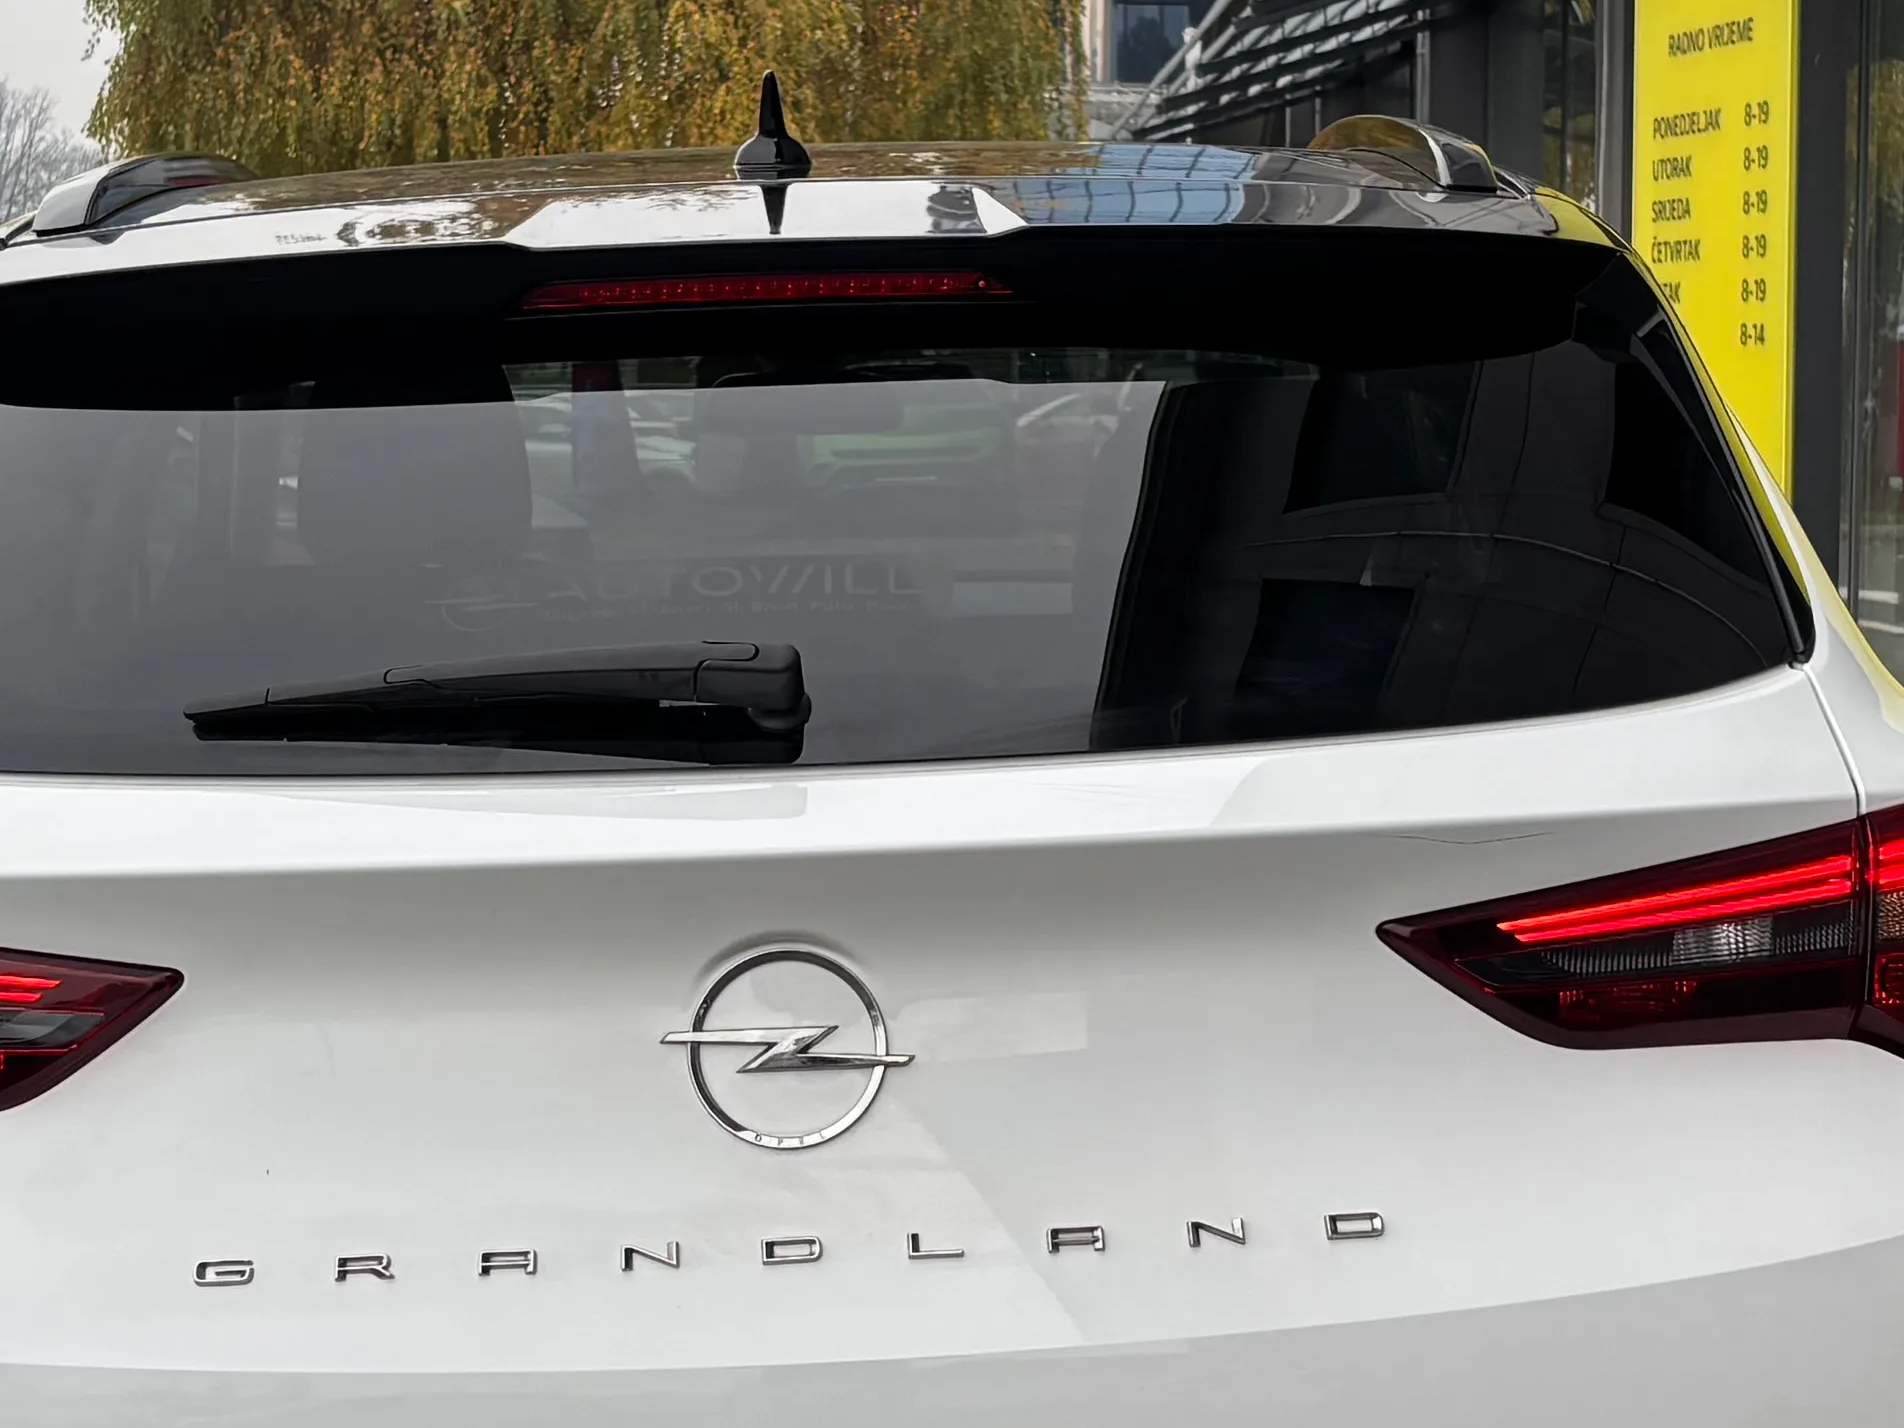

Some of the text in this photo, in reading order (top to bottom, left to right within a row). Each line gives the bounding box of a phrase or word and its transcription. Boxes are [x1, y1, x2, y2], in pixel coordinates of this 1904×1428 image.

[1668, 17, 1754, 58] RADNO VRIJEME
[1653, 100, 1770, 139] PONEDJELJAK 8-19
[1652, 145, 1769, 182] UTORAK 8-19
[1651, 190, 1768, 223] SRIJEDA 8-19
[1651, 234, 1768, 264] ČETVRTAK 8-19
[1741, 278, 1767, 303] 8-19
[1740, 322, 1766, 346] 8-14
[192, 1210, 1386, 1287] GRANDLAND
